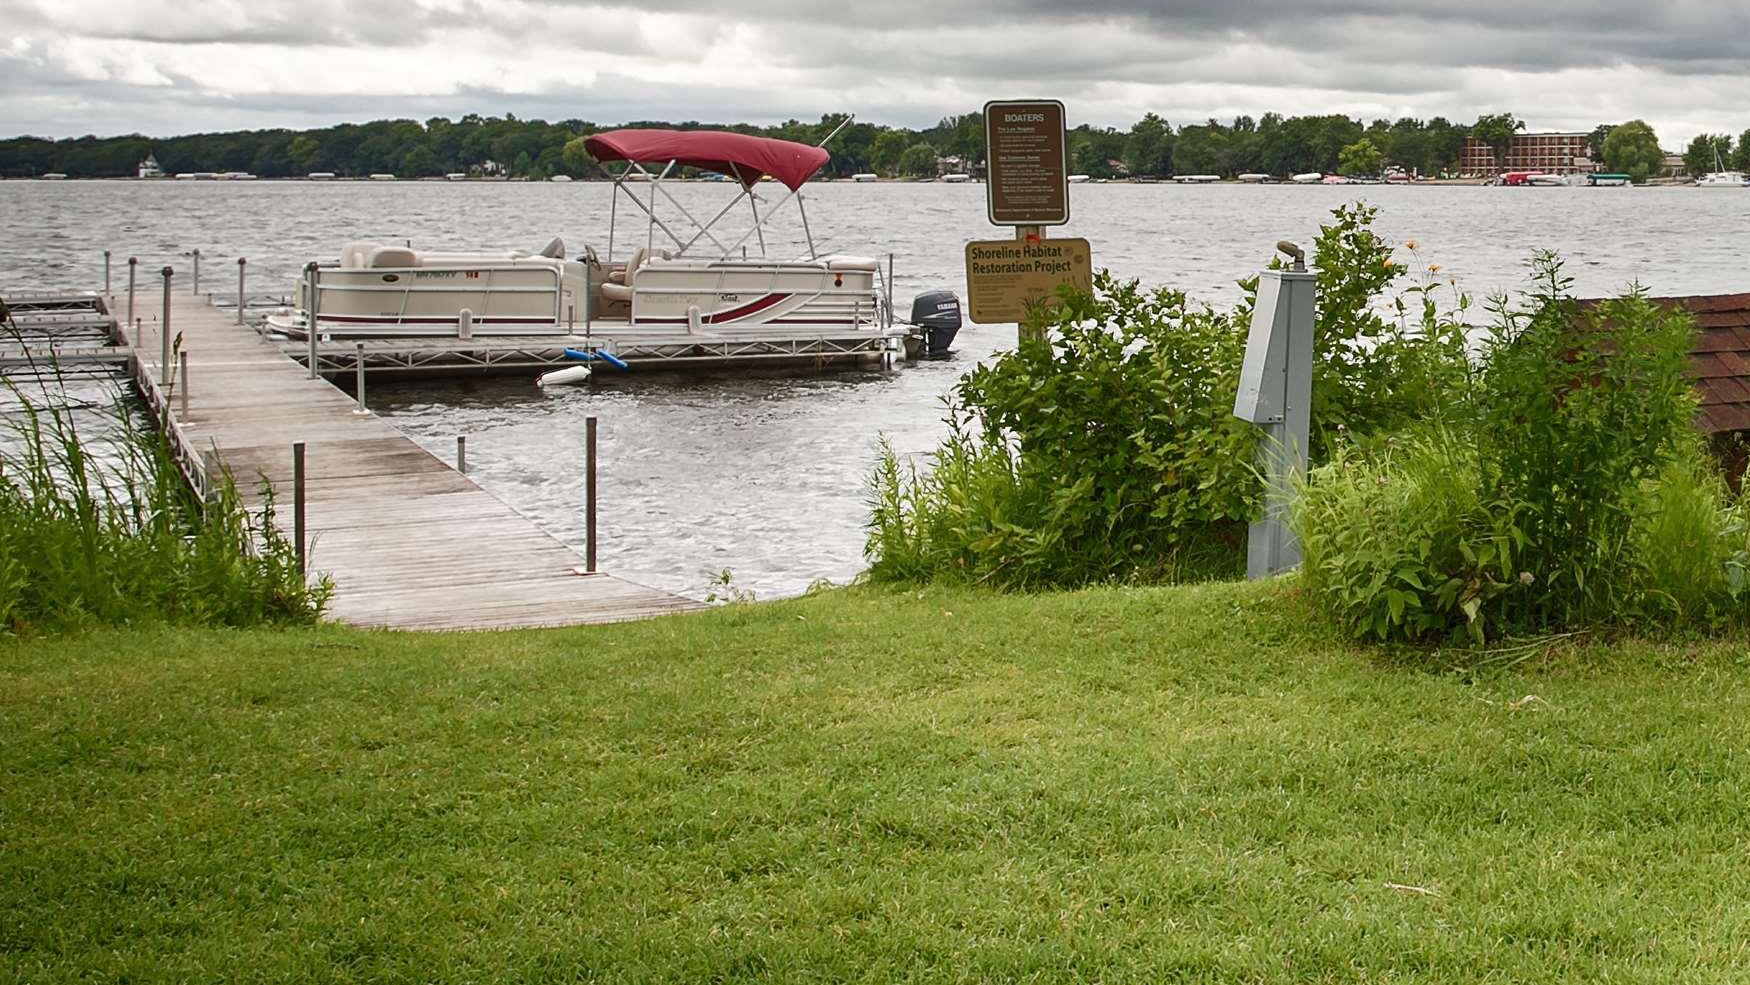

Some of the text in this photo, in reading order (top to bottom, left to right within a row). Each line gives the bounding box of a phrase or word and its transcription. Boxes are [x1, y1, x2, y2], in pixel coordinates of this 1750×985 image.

[1004, 113, 1045, 123] BOATERS
[971, 245, 1062, 260] Shoreline Habitat
[972, 260, 1072, 275] Restoration Project
